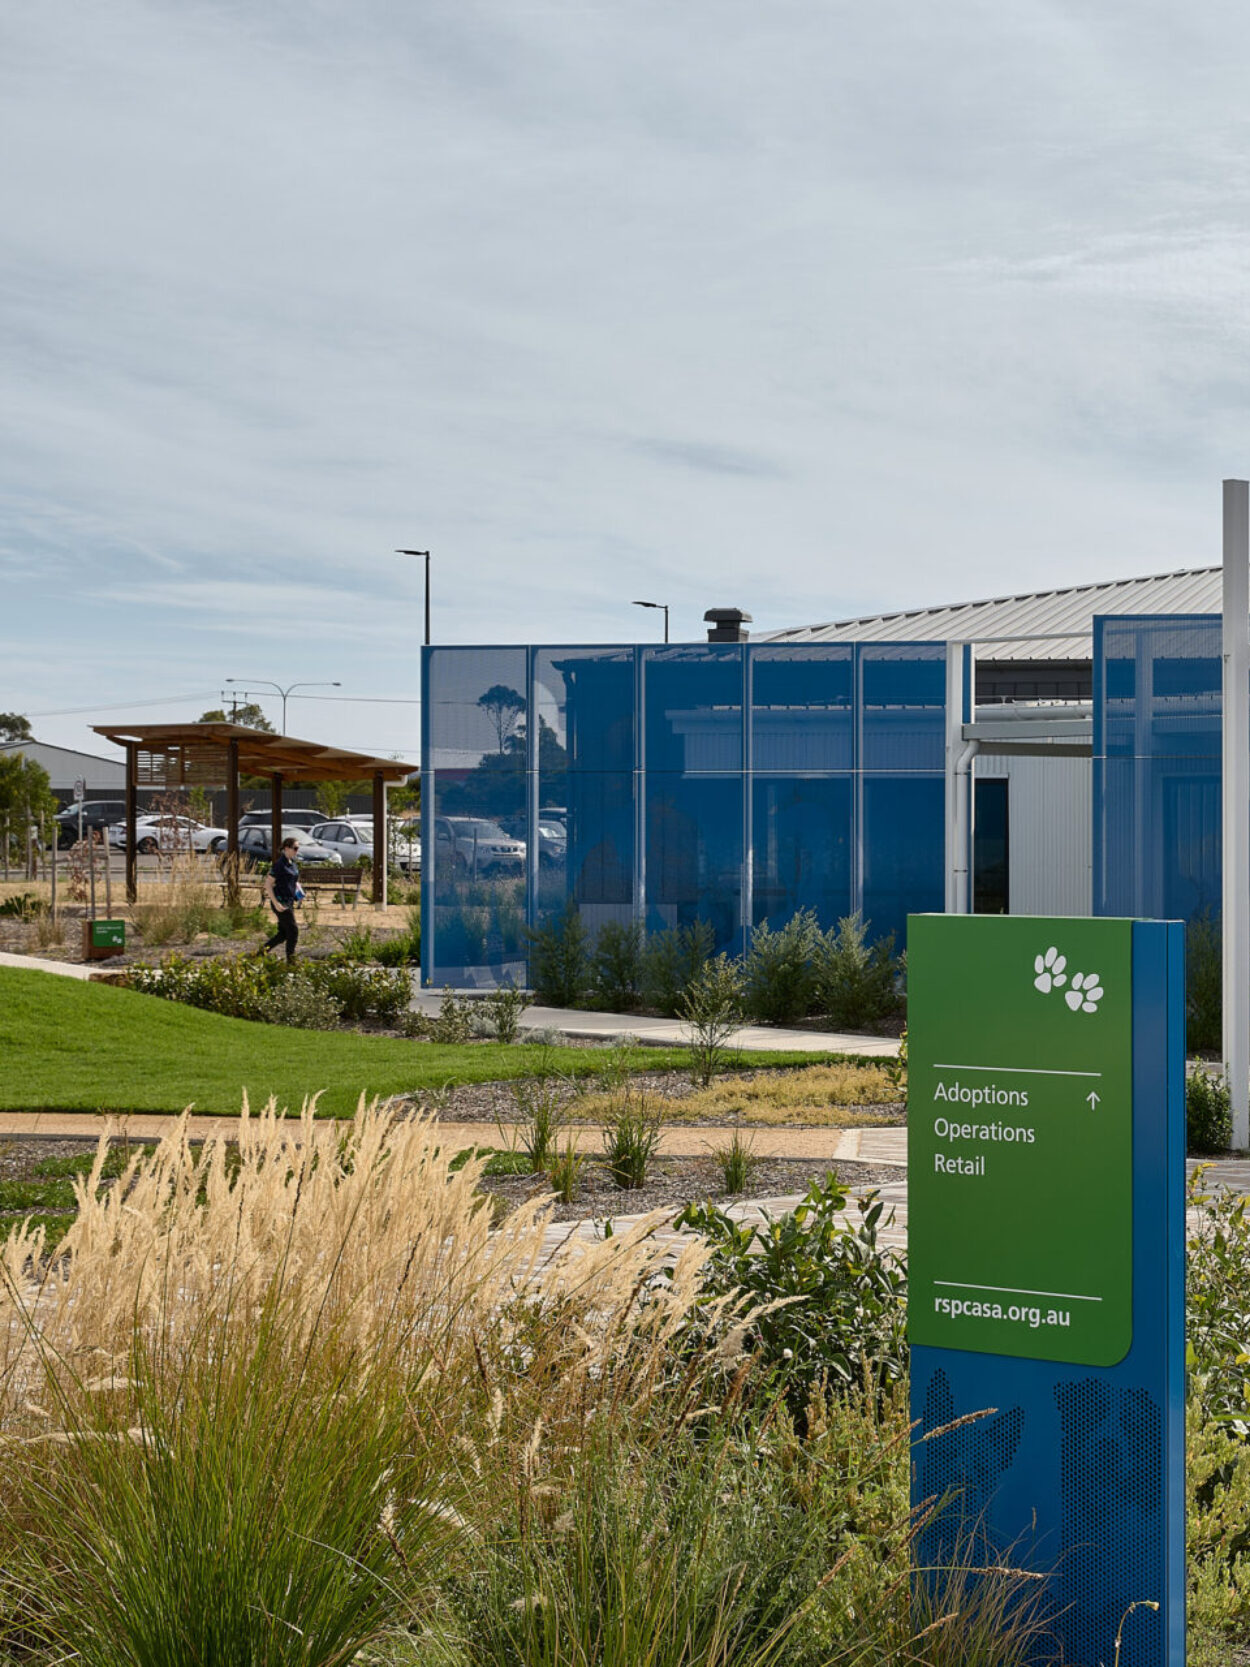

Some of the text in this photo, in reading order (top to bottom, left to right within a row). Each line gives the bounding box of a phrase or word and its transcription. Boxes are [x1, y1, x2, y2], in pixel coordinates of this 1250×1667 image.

[933, 1082, 1029, 1109] Adoptions
[934, 1118, 1035, 1144] Operations
[934, 1154, 985, 1176] Retail
[934, 1296, 1070, 1328] rspcasa.org.au
